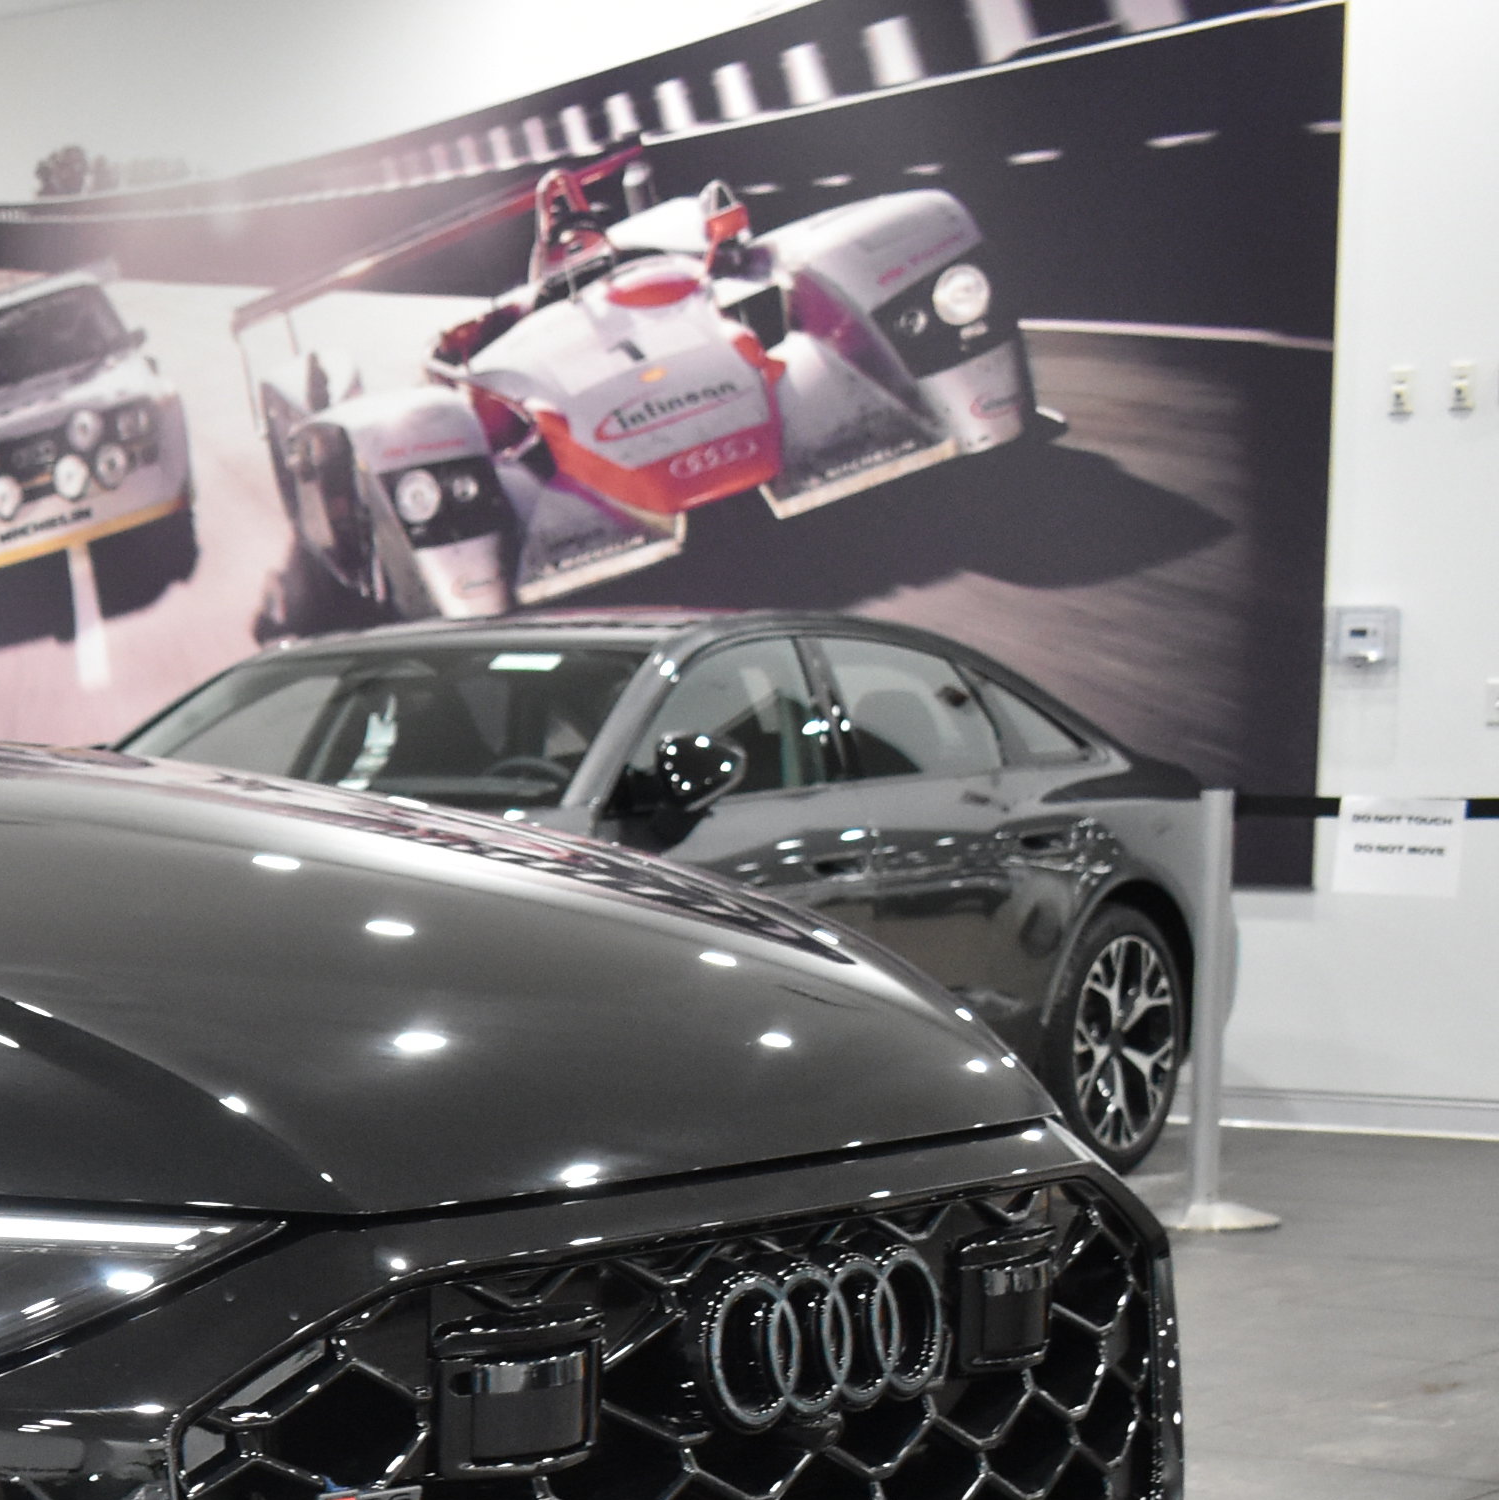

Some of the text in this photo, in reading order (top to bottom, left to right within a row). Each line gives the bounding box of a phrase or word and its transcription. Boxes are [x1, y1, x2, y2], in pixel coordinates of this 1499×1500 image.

[612, 382, 738, 430] Infineon
[1352, 814, 1453, 826] DO NOT TOUCH
[1354, 844, 1445, 856] DO NOT MOVE
